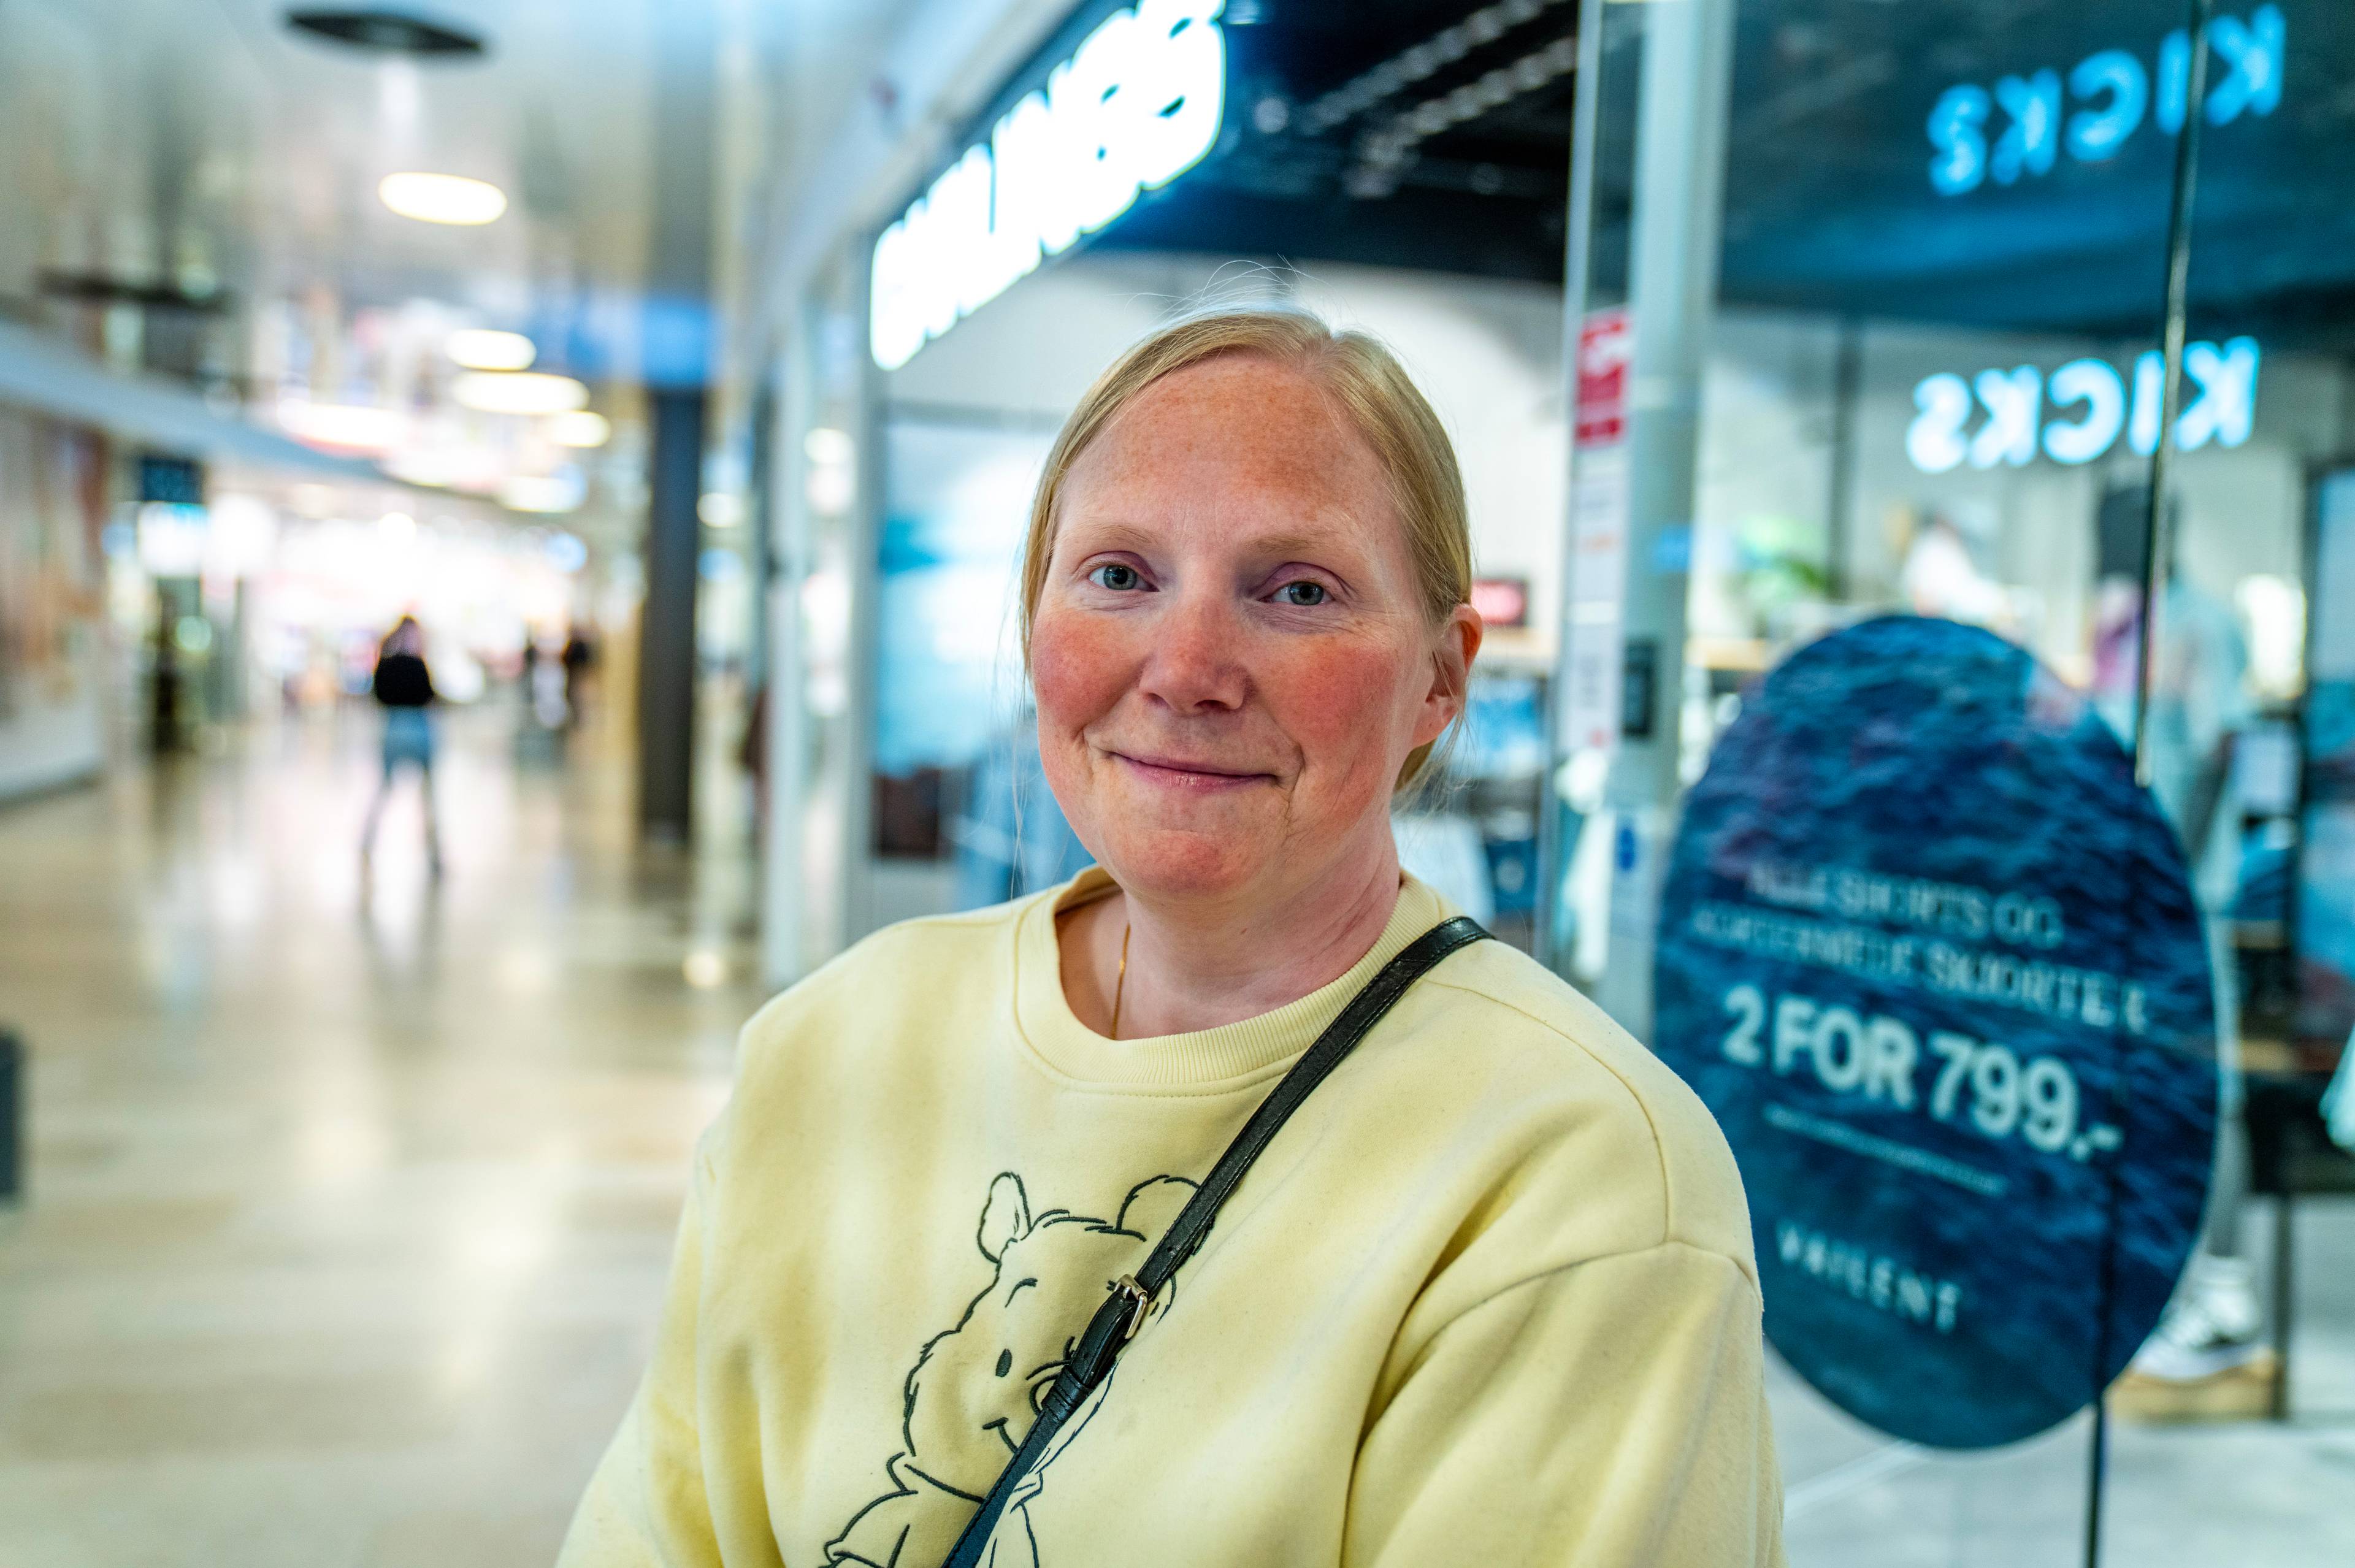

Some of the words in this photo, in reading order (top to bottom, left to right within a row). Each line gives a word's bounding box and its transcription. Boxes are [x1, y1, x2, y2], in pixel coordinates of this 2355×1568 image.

[1837, 868, 1990, 939] SHORTS
[1993, 891, 2064, 949] OG
[1720, 984, 1763, 1068] 2
[1772, 992, 1918, 1110] FOR
[1927, 1029, 2123, 1160] 799.-
